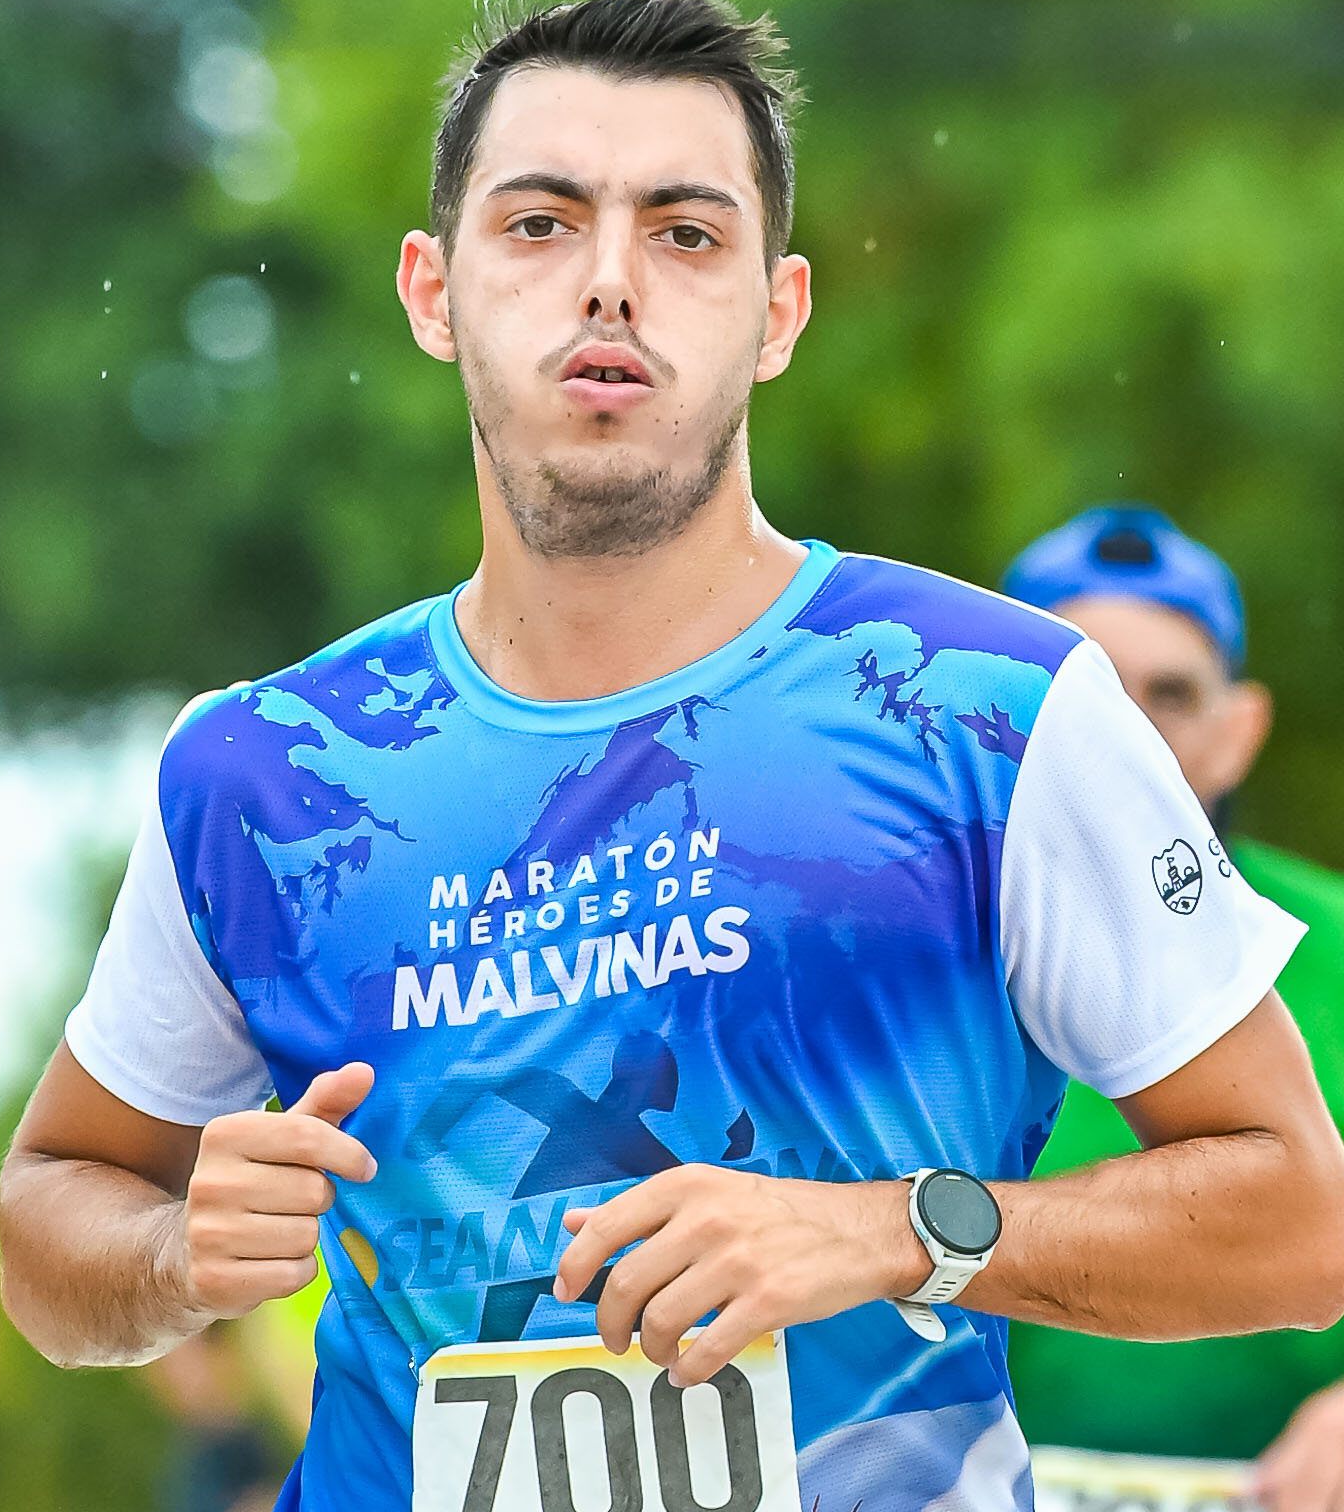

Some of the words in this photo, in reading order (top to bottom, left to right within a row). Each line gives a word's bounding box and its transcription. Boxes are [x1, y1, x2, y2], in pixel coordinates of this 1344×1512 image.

[429, 827, 720, 909] MARATÓN
[429, 889, 631, 948] HÉROES
[656, 867, 713, 907] DE
[393, 906, 750, 1030] MALVINAS
